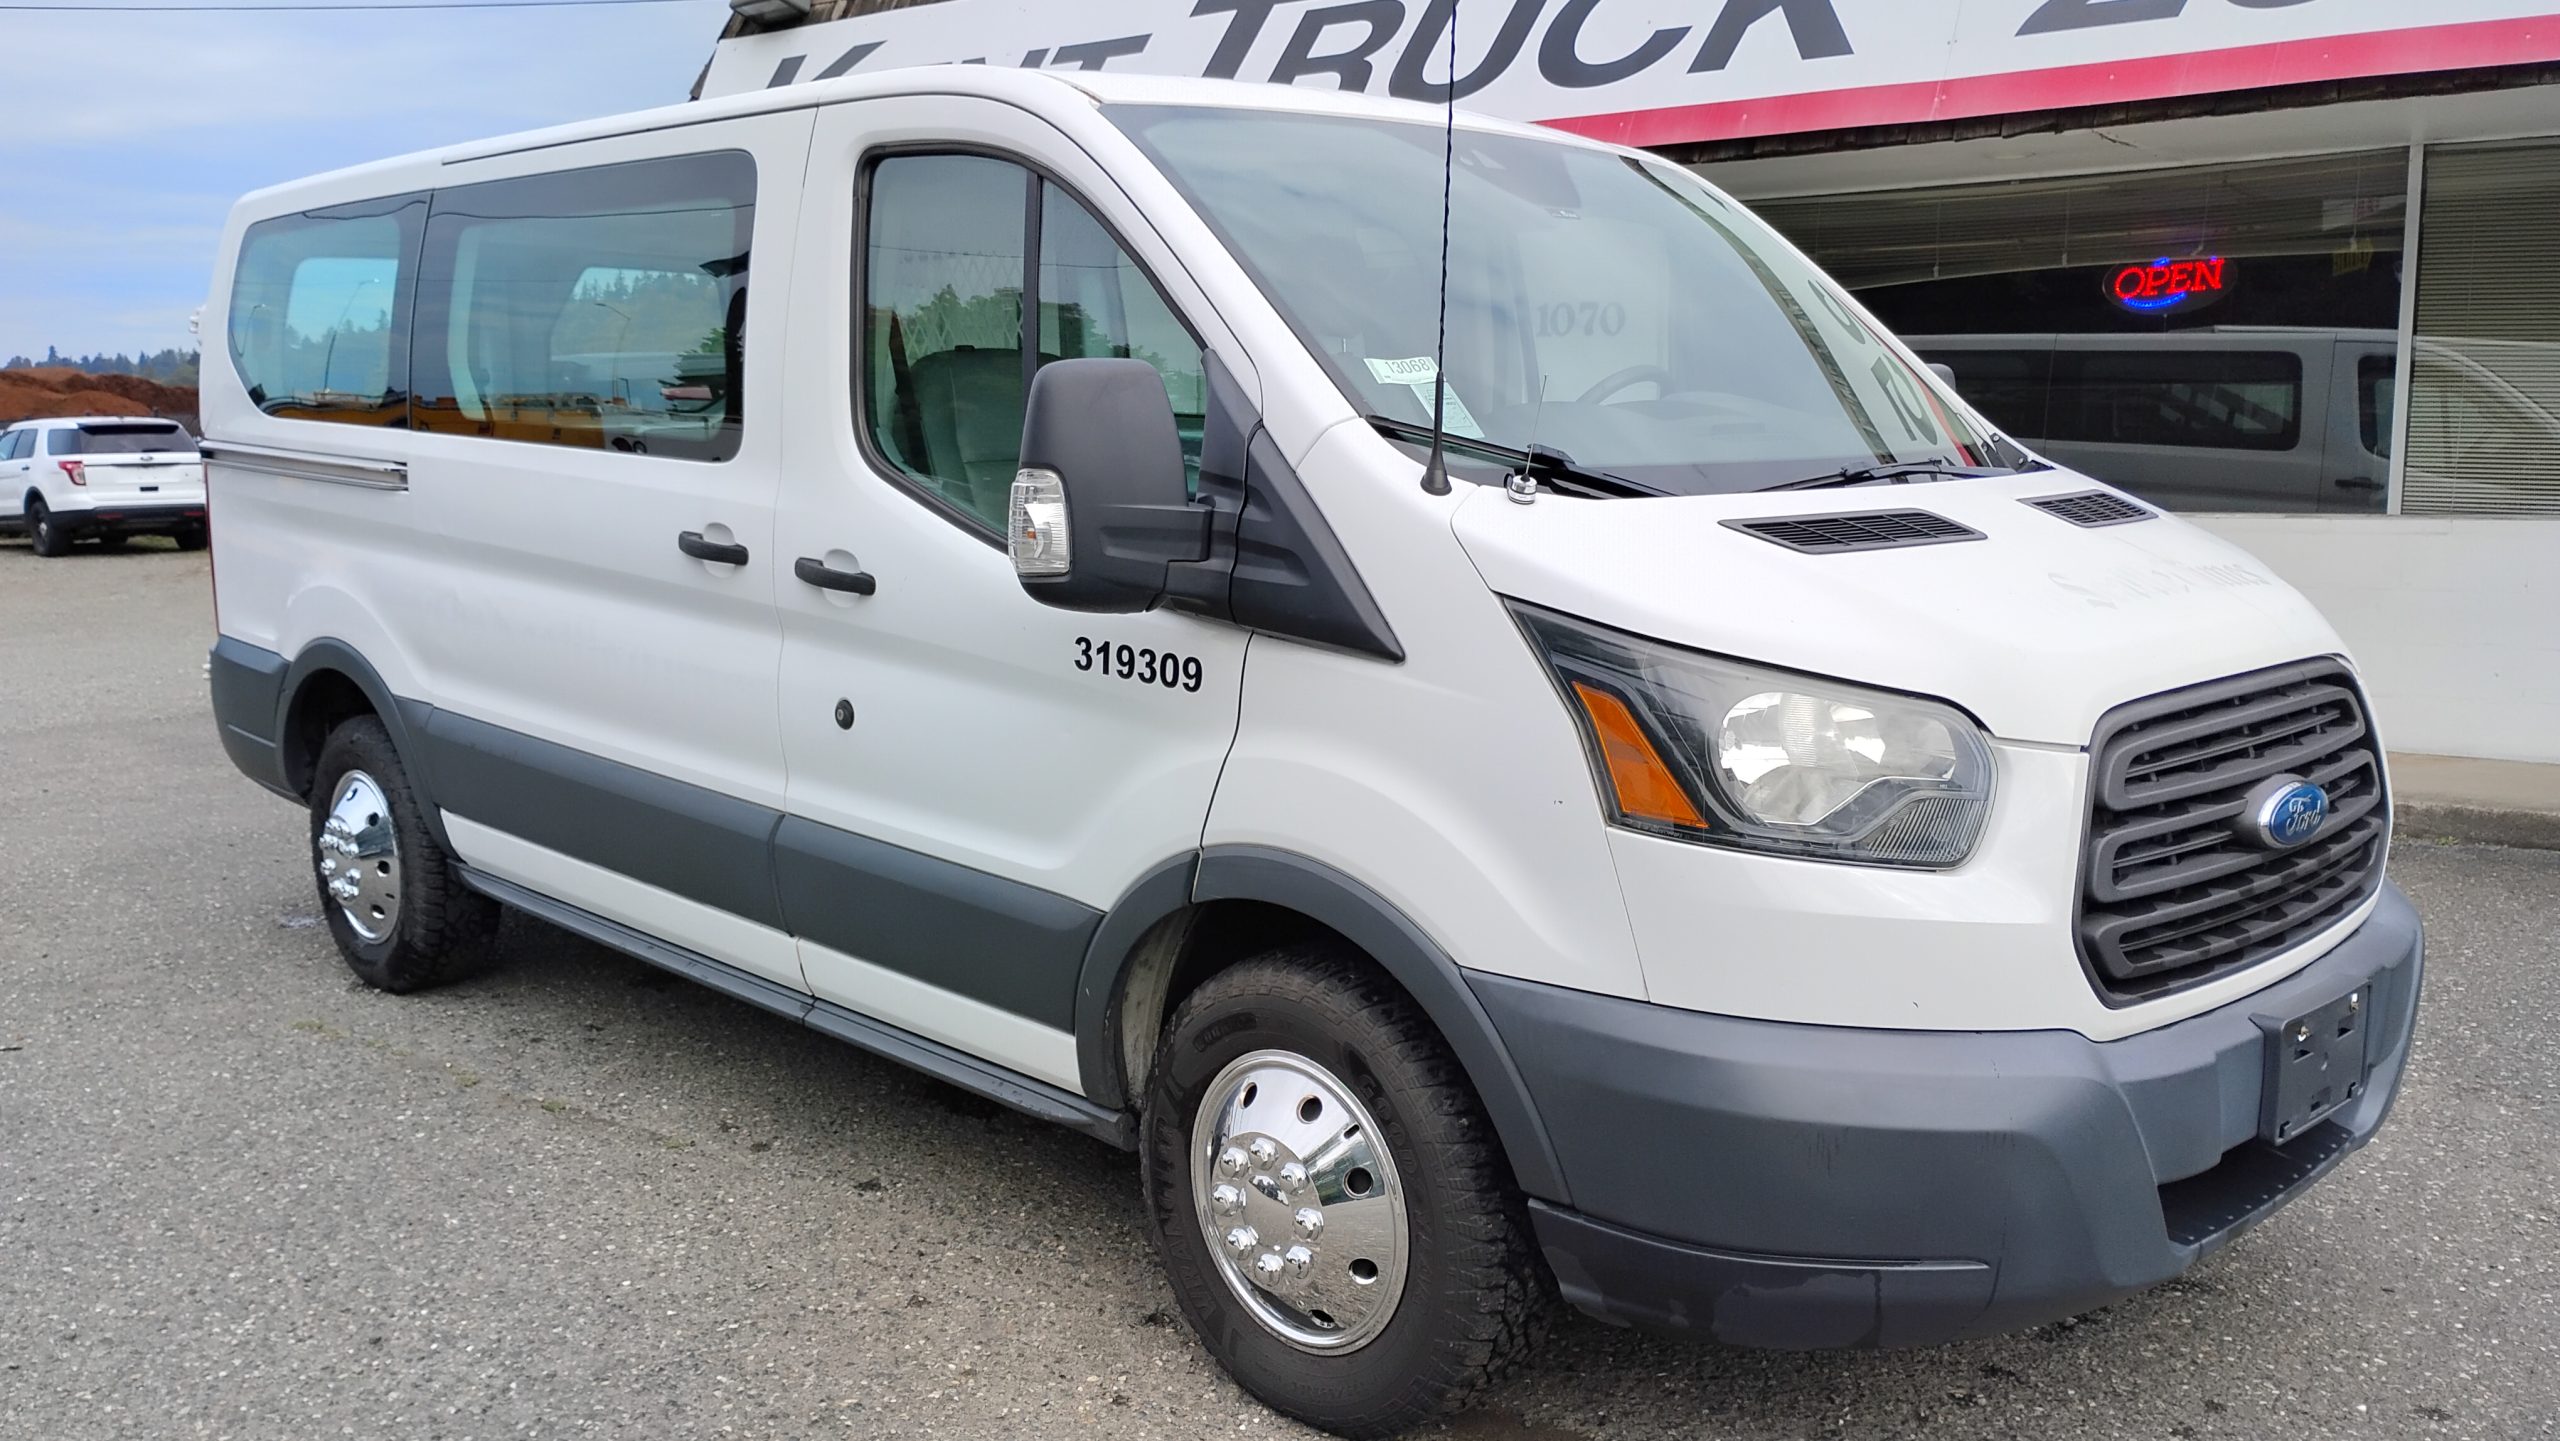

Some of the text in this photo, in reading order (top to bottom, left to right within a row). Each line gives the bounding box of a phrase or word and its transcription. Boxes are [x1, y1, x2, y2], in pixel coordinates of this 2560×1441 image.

[1189, 0, 1854, 104] TRUCK
[2114, 258, 2225, 300] OPEN
[1536, 302, 1627, 338] 1070
[1384, 358, 1431, 375] 13068
[1074, 636, 1203, 693] 319309
[2286, 793, 2321, 836] Ford
